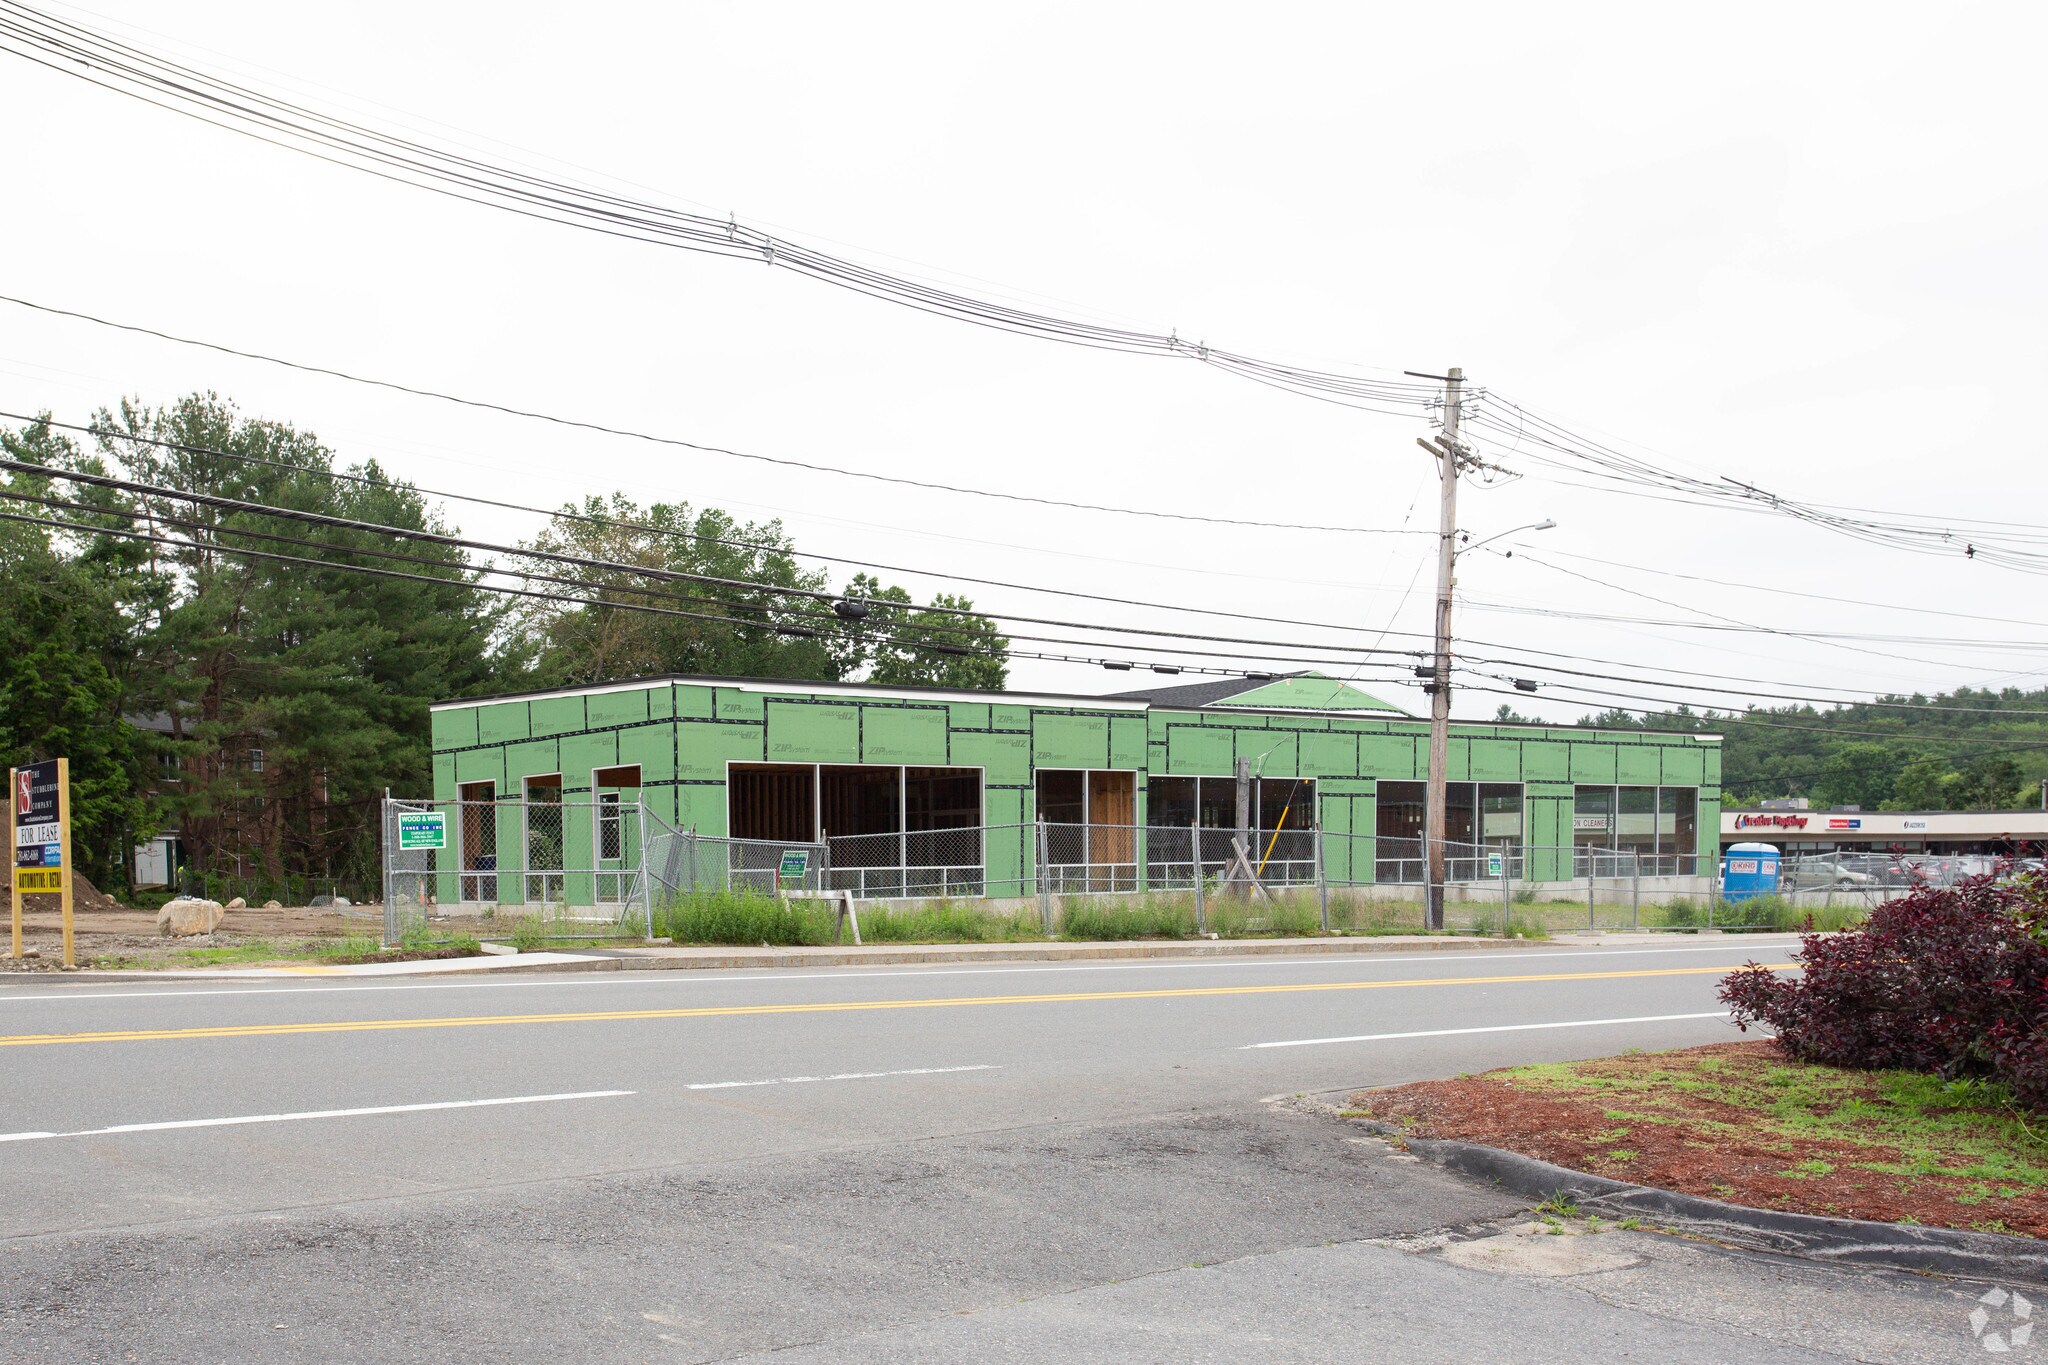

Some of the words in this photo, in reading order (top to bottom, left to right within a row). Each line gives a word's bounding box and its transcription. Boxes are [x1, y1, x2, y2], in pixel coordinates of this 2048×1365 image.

[32, 800, 52, 810] COMPANY
[1744, 815, 1772, 826] Creative
[1773, 815, 1808, 830] Playthings
[22, 828, 34, 844] FOR
[38, 825, 58, 842] LEASE
[19, 873, 45, 888] AUTOMOTIVE
